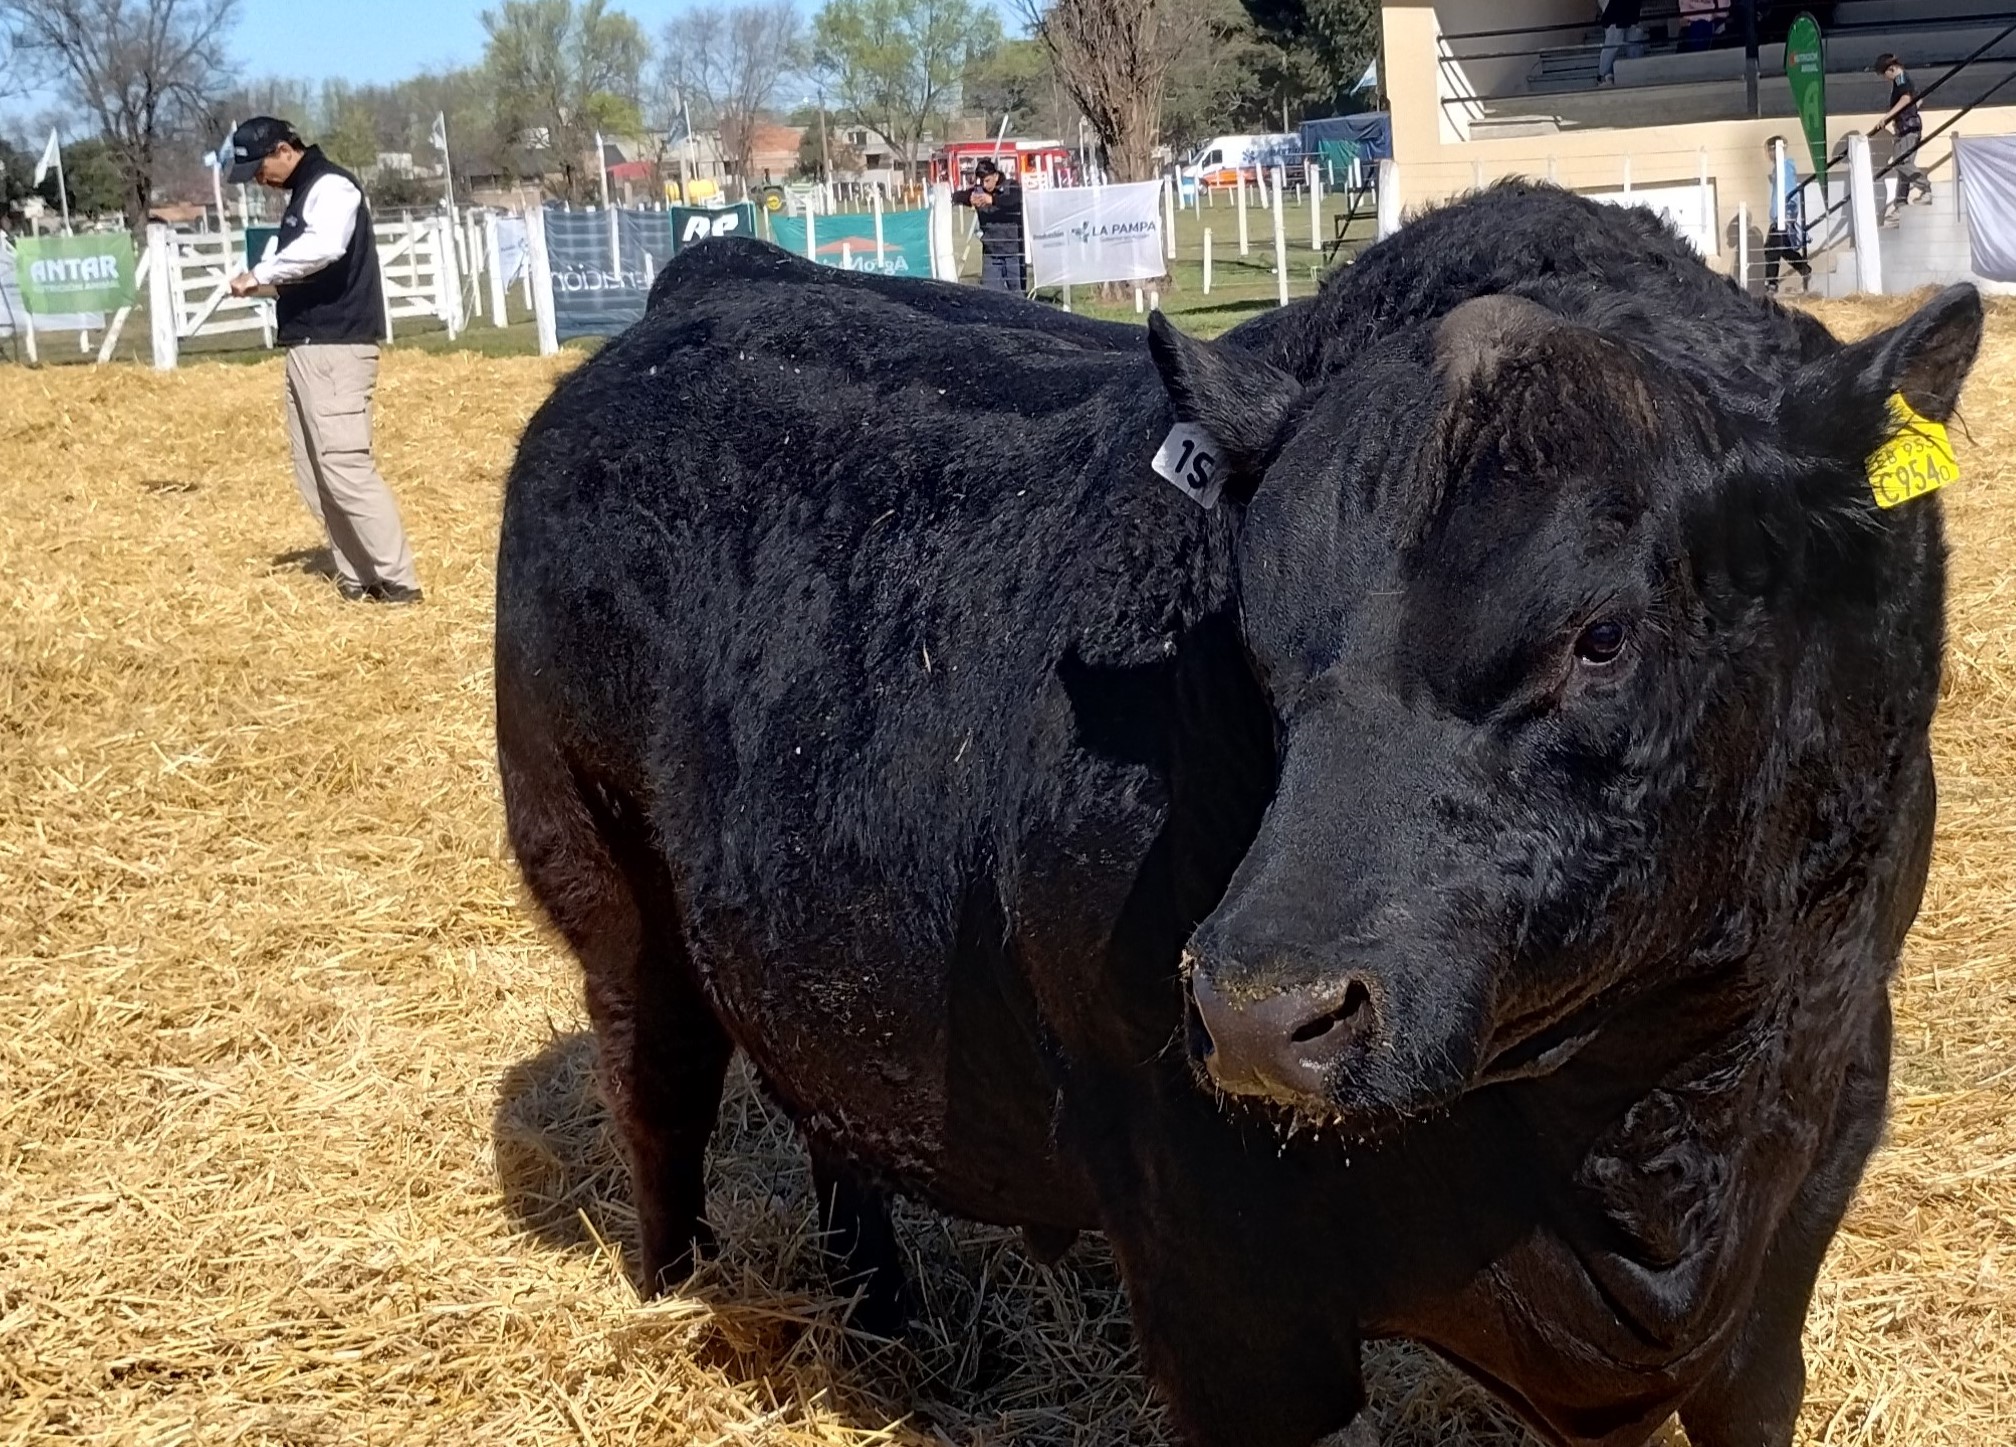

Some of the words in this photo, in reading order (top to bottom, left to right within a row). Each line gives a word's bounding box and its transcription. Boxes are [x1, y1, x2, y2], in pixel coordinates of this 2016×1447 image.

[1092, 225, 1109, 237] LA
[1112, 221, 1156, 235] PAMPA
[30, 255, 120, 283] ANTAR
